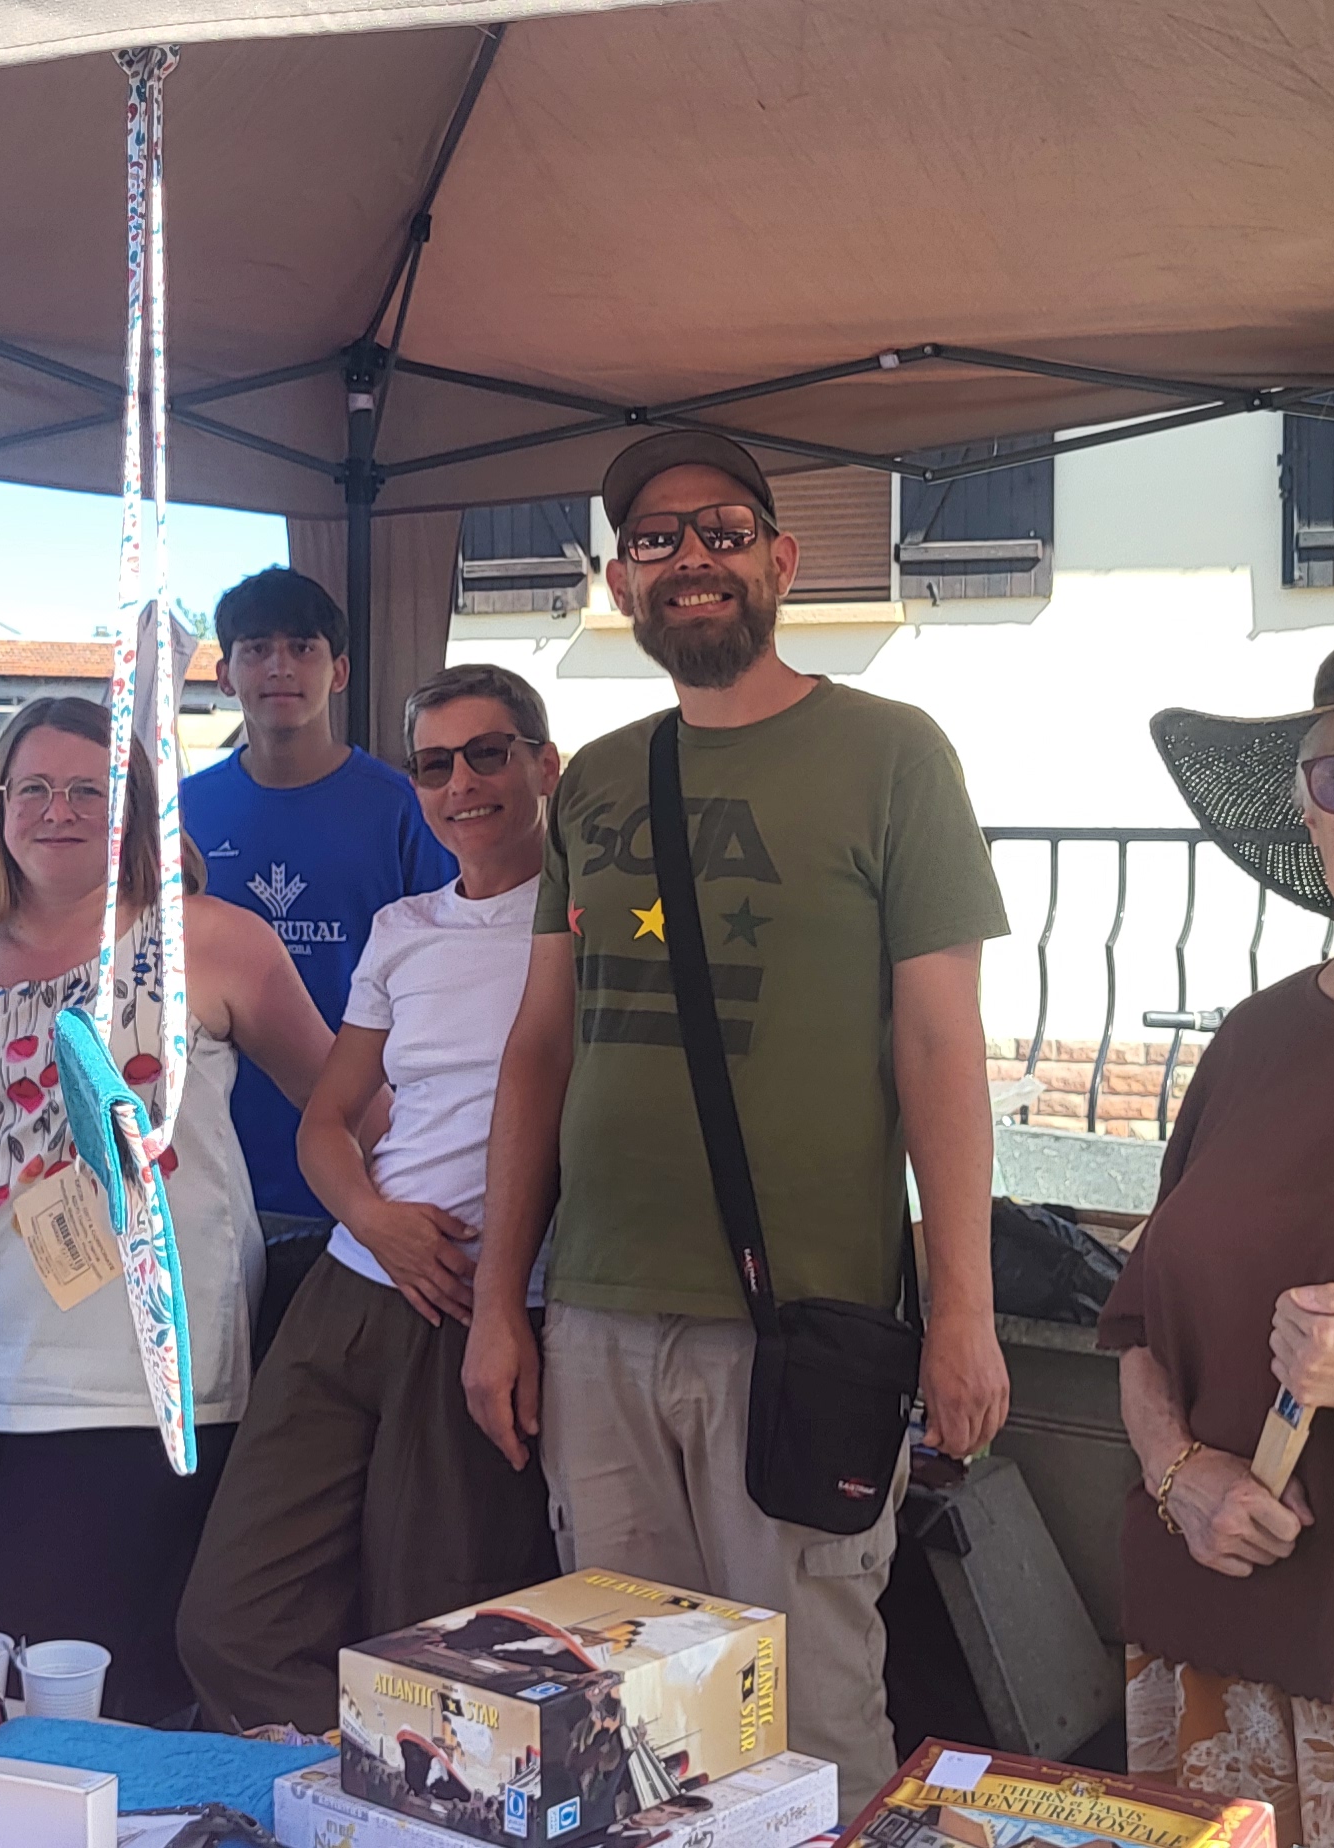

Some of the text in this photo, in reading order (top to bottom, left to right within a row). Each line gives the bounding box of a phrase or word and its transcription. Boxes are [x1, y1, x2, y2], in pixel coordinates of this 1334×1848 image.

[272, 920, 347, 942] RURAL
[583, 1574, 667, 1601] ATLANTIC
[374, 1672, 500, 1729] ATLANTIC STAR
[757, 1636, 775, 1727] ATLANTIC
[740, 1702, 757, 1753] STAR
[997, 1782, 1067, 1805] THURN
[1088, 1799, 1147, 1823] TAXIS
[1081, 1812, 1191, 1848] POSTALE
